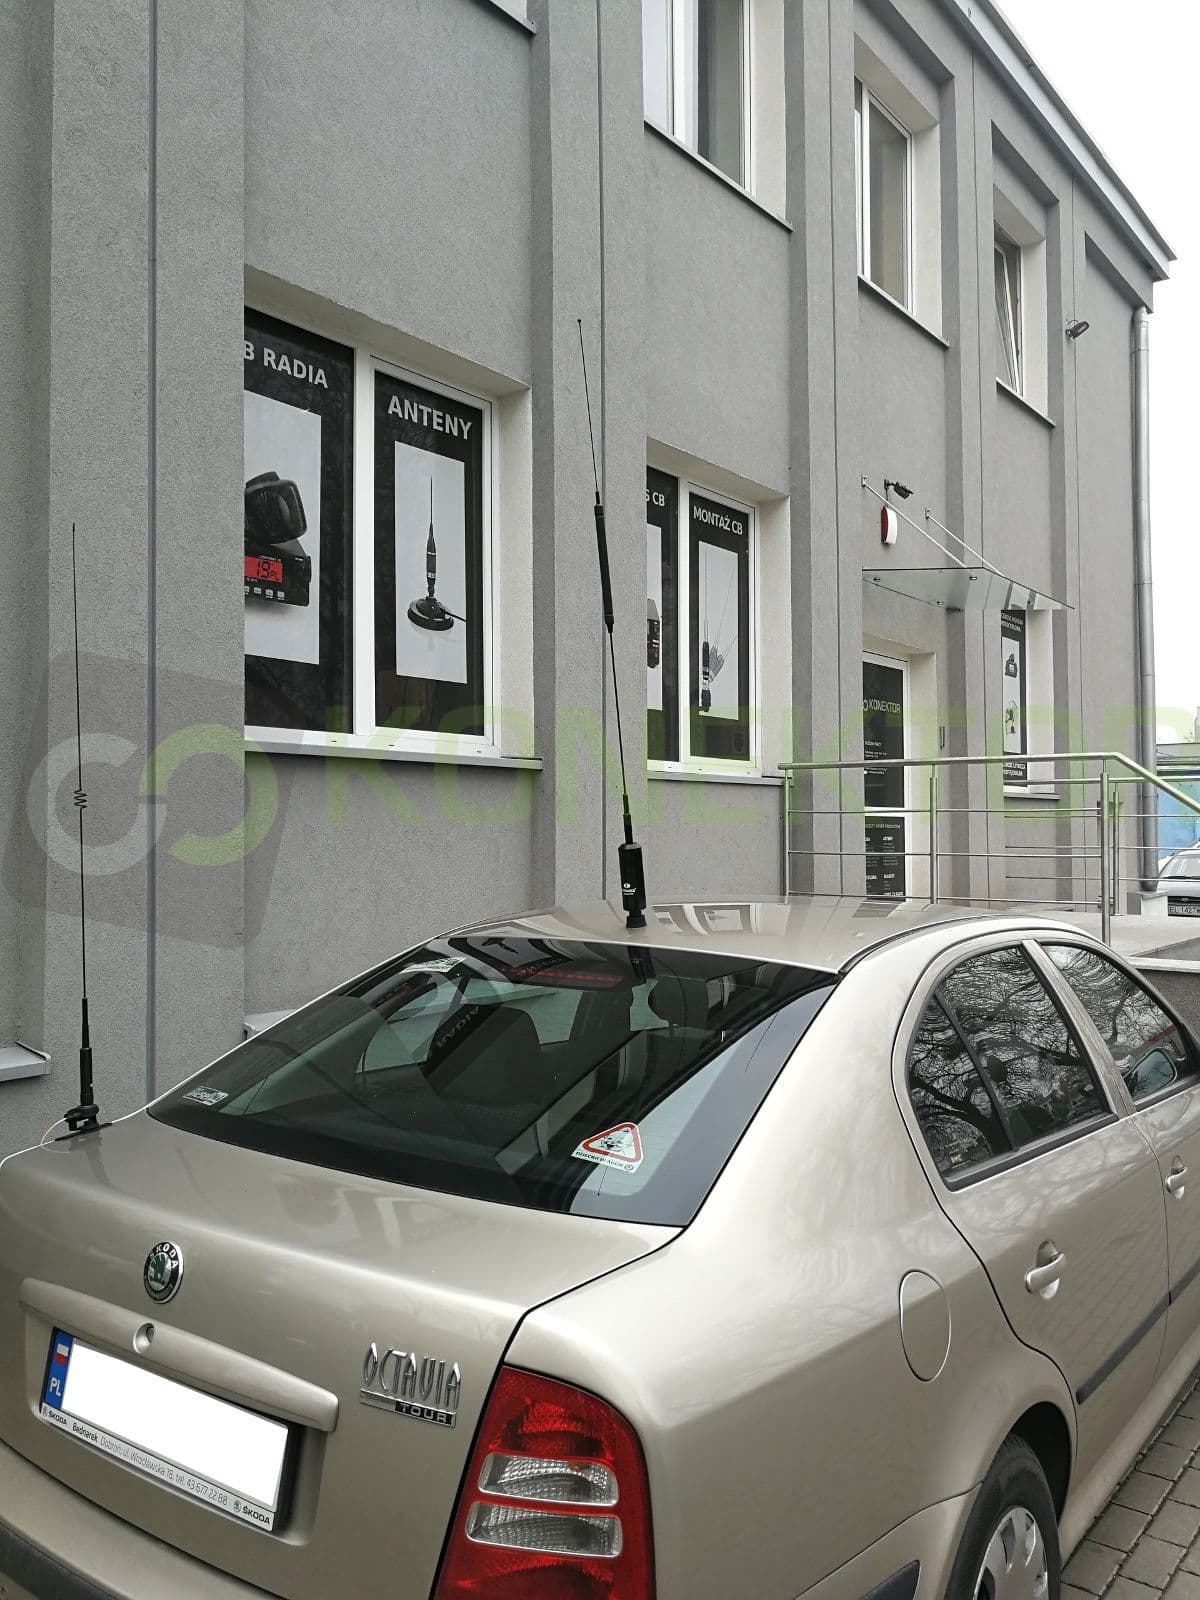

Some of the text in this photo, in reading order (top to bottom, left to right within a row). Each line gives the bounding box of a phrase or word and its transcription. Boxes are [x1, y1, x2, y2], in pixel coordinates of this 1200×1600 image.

[263, 347, 329, 389] RADIA
[387, 394, 473, 441] ANTENY
[652, 491, 665, 507] CB
[693, 505, 743, 535] MONTAŻ CB
[49, 1376, 62, 1397] PL
[362, 1342, 461, 1410] OCTAVIA
[400, 1403, 447, 1423] TOUR
[72, 1422, 98, 1443] Bednarek
